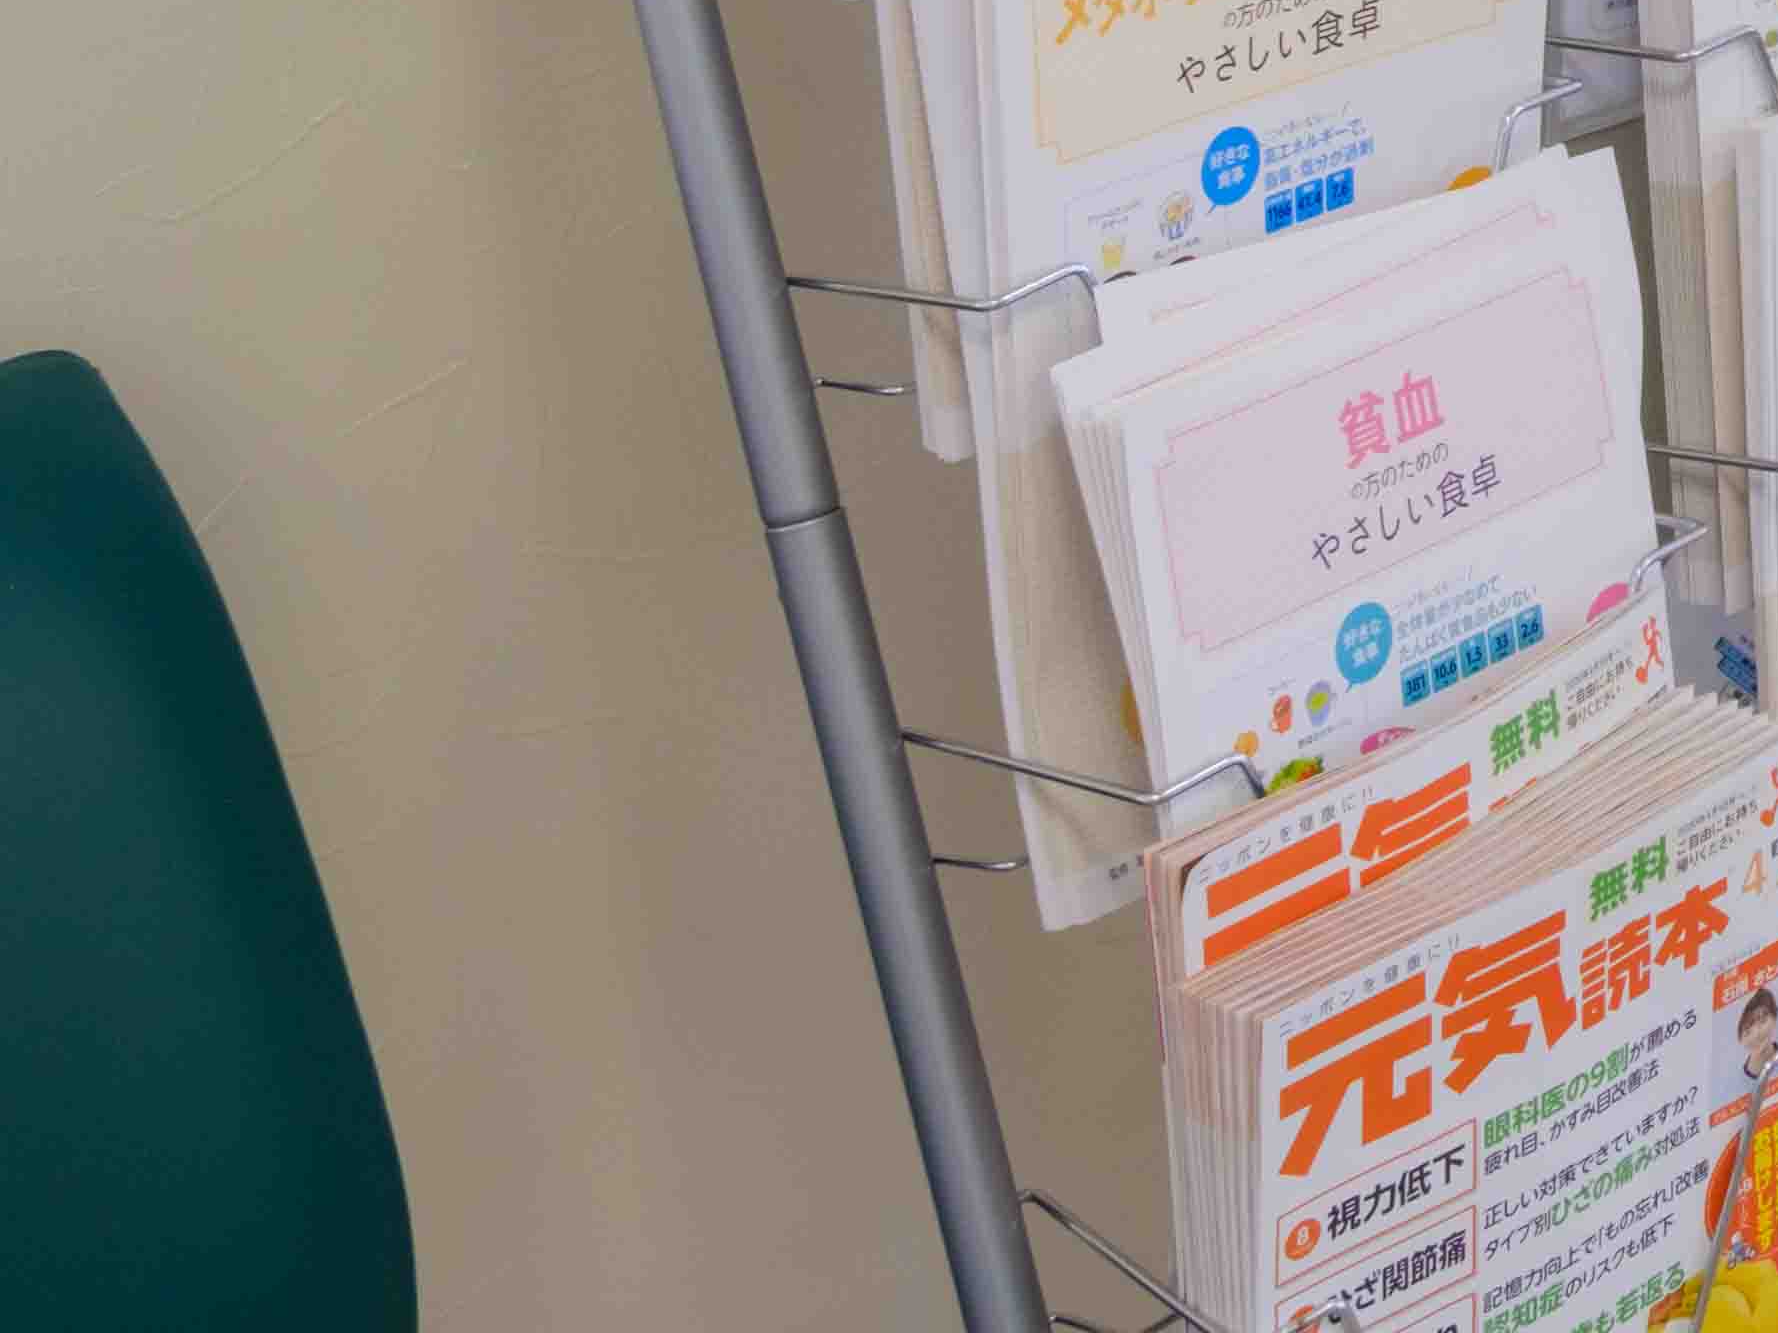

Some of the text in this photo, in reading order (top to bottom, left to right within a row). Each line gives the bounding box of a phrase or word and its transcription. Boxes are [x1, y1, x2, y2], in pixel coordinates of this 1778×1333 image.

[1177, 0, 1382, 94] やさしい食卓
[1337, 371, 1445, 468] 貧血
[1311, 454, 1502, 570] やさしい食卓
[1350, 440, 1449, 499] の方のための
[1490, 691, 1560, 776] 無料
[1589, 836, 1669, 922] 無料
[1279, 876, 1730, 1177] 元気読本
[1326, 1145, 1466, 1240] 視力低下
[1483, 1117, 1700, 1260] タイプ別ひざの痛み対処法
